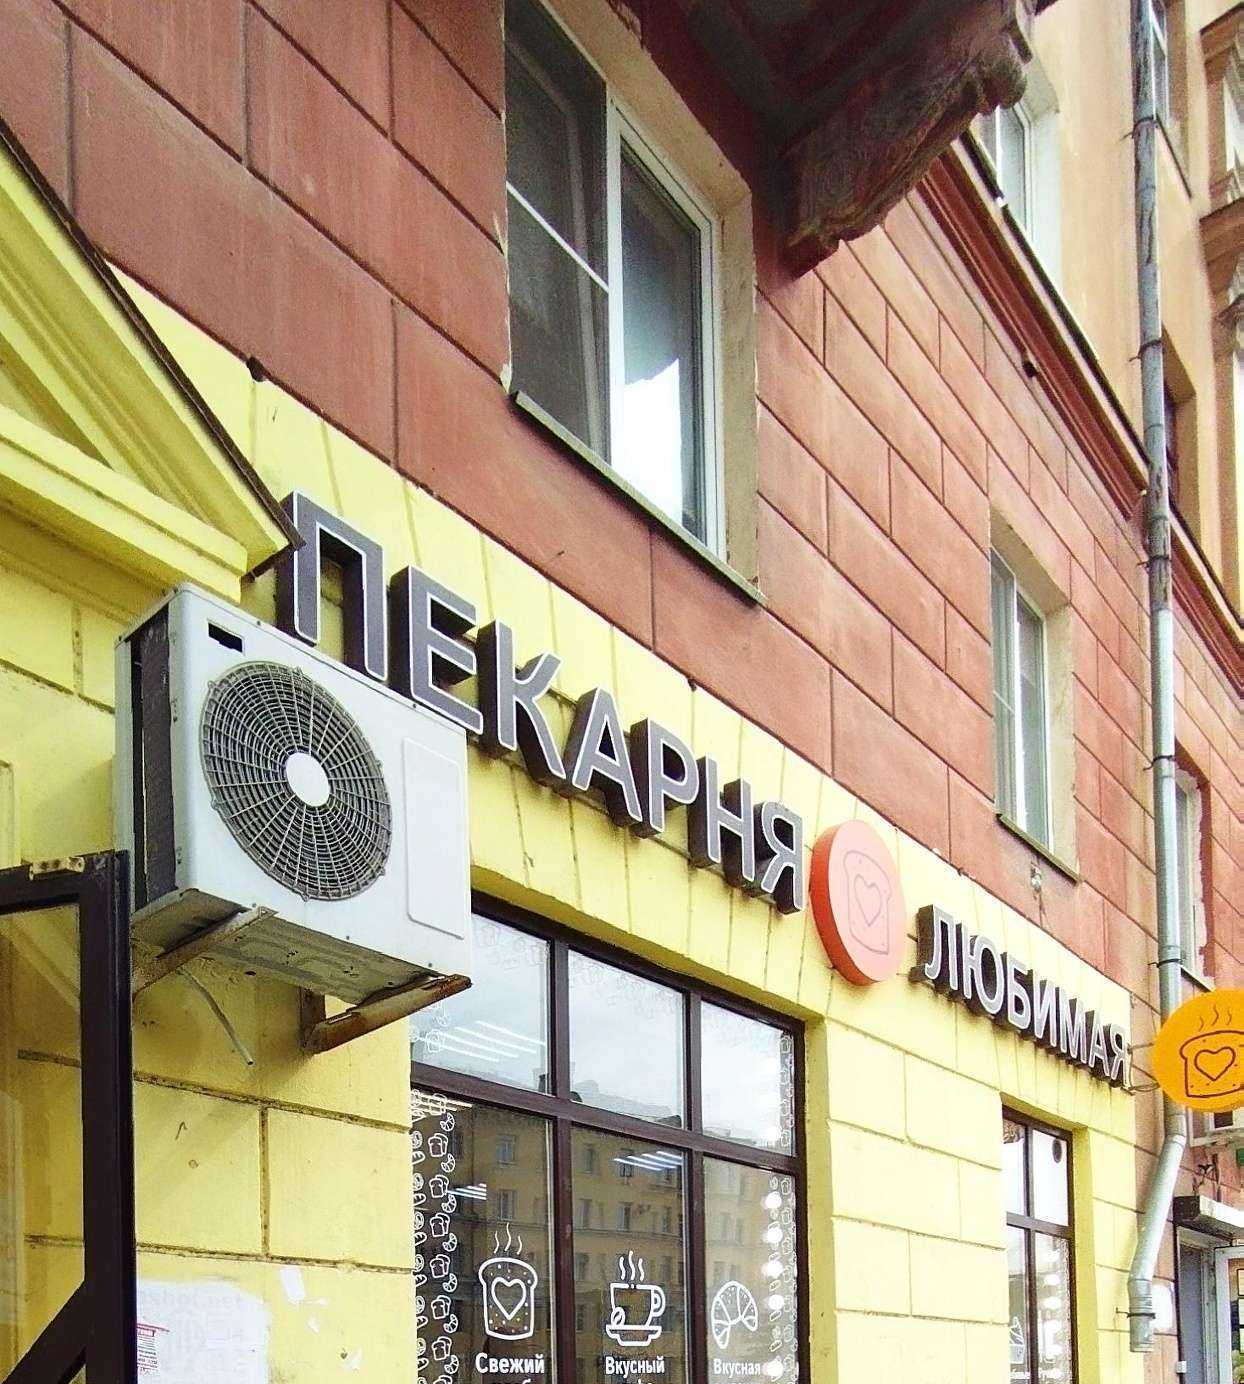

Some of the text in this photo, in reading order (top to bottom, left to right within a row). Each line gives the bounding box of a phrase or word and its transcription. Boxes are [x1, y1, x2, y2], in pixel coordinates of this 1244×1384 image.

[291, 489, 803, 912] ПЕКАРНЯ
[923, 903, 1132, 1090] ЛЮБИМАЯ
[475, 1352, 545, 1375] Свежий
[605, 1355, 665, 1378] Вкусный
[713, 1358, 761, 1379] Вкусная
